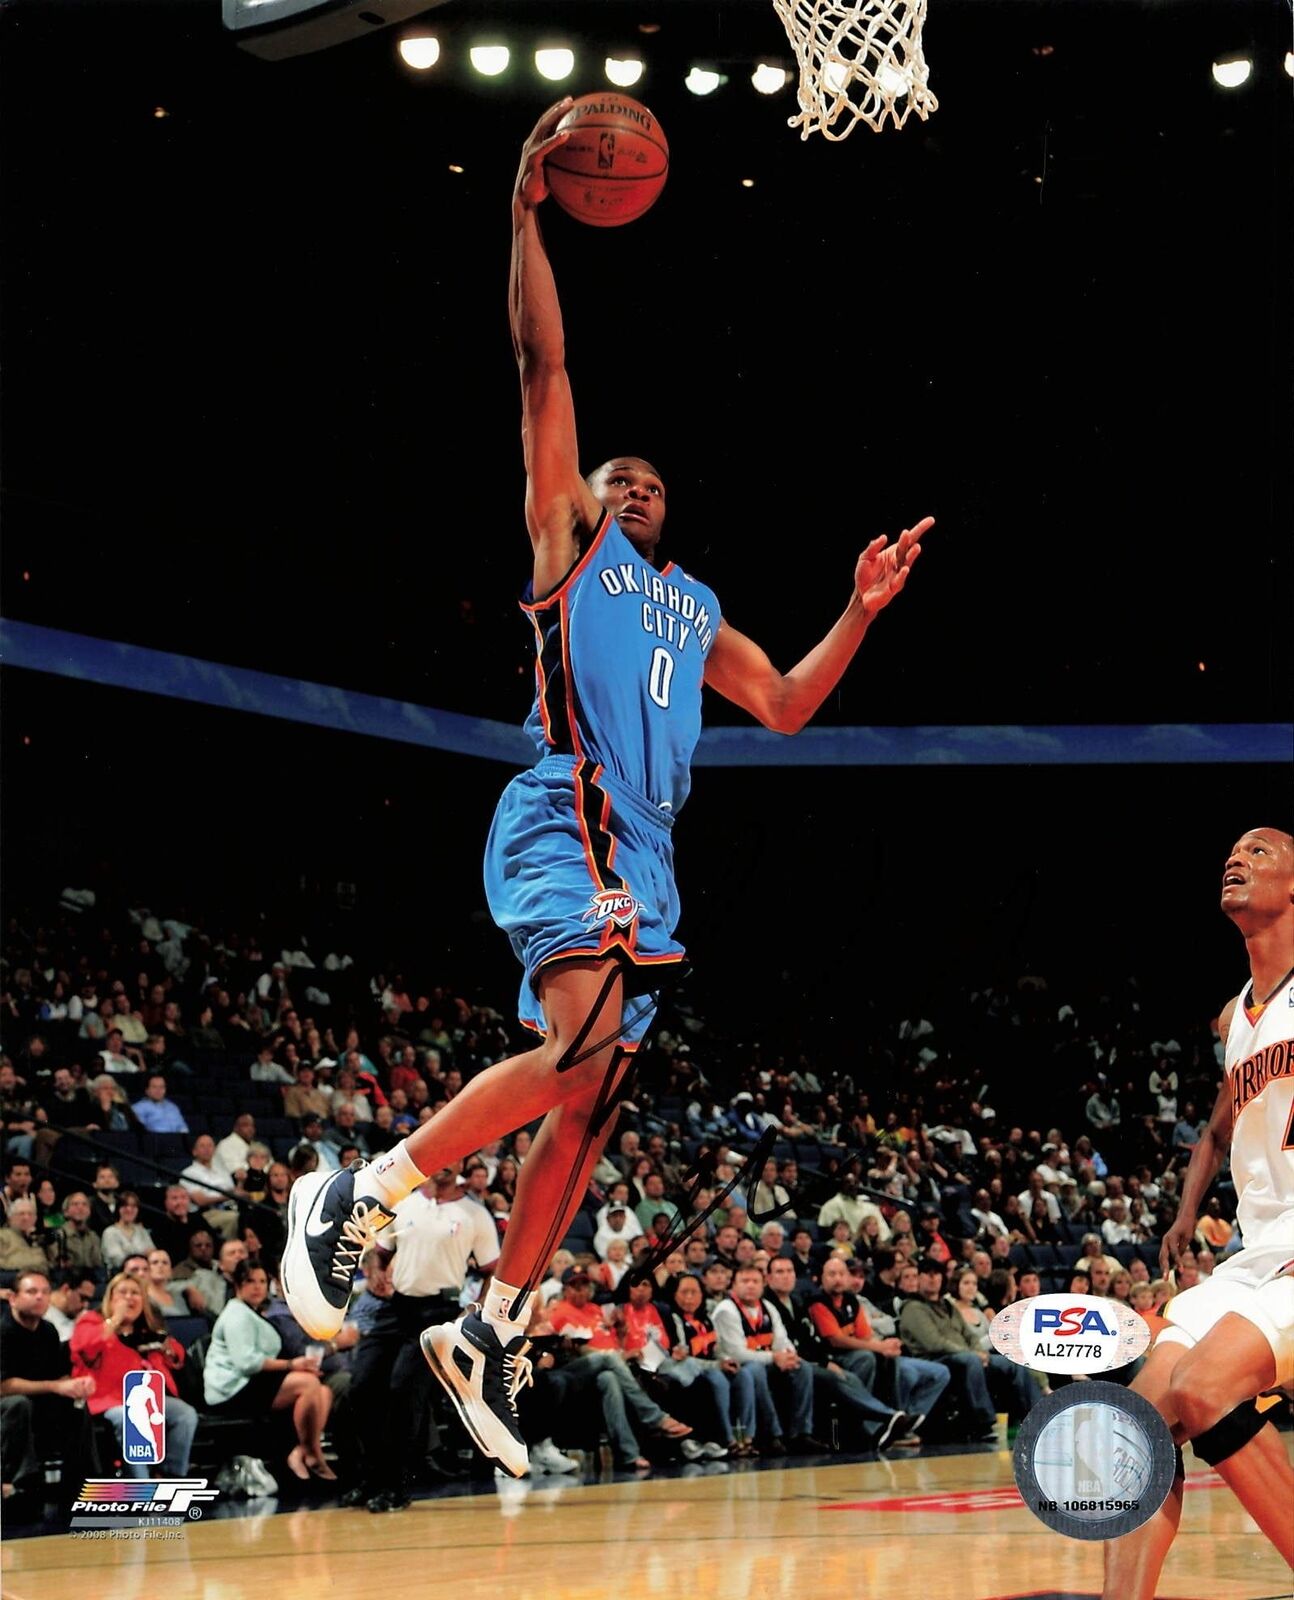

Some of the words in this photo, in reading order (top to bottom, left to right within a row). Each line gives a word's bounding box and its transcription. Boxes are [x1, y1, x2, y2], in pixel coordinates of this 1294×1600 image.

[571, 103, 652, 131] PALDING
[600, 563, 713, 653] OKLAHOMA
[641, 602, 691, 652] CITY
[648, 646, 675, 710] 0
[596, 896, 631, 920] OKC
[1231, 1040, 1294, 1119] ARRIOR
[1034, 1342, 1103, 1359] AL27778
[1077, 1480, 1102, 1493] NBA
[1038, 1501, 1057, 1512] NB
[1062, 1500, 1140, 1512] 106815965
